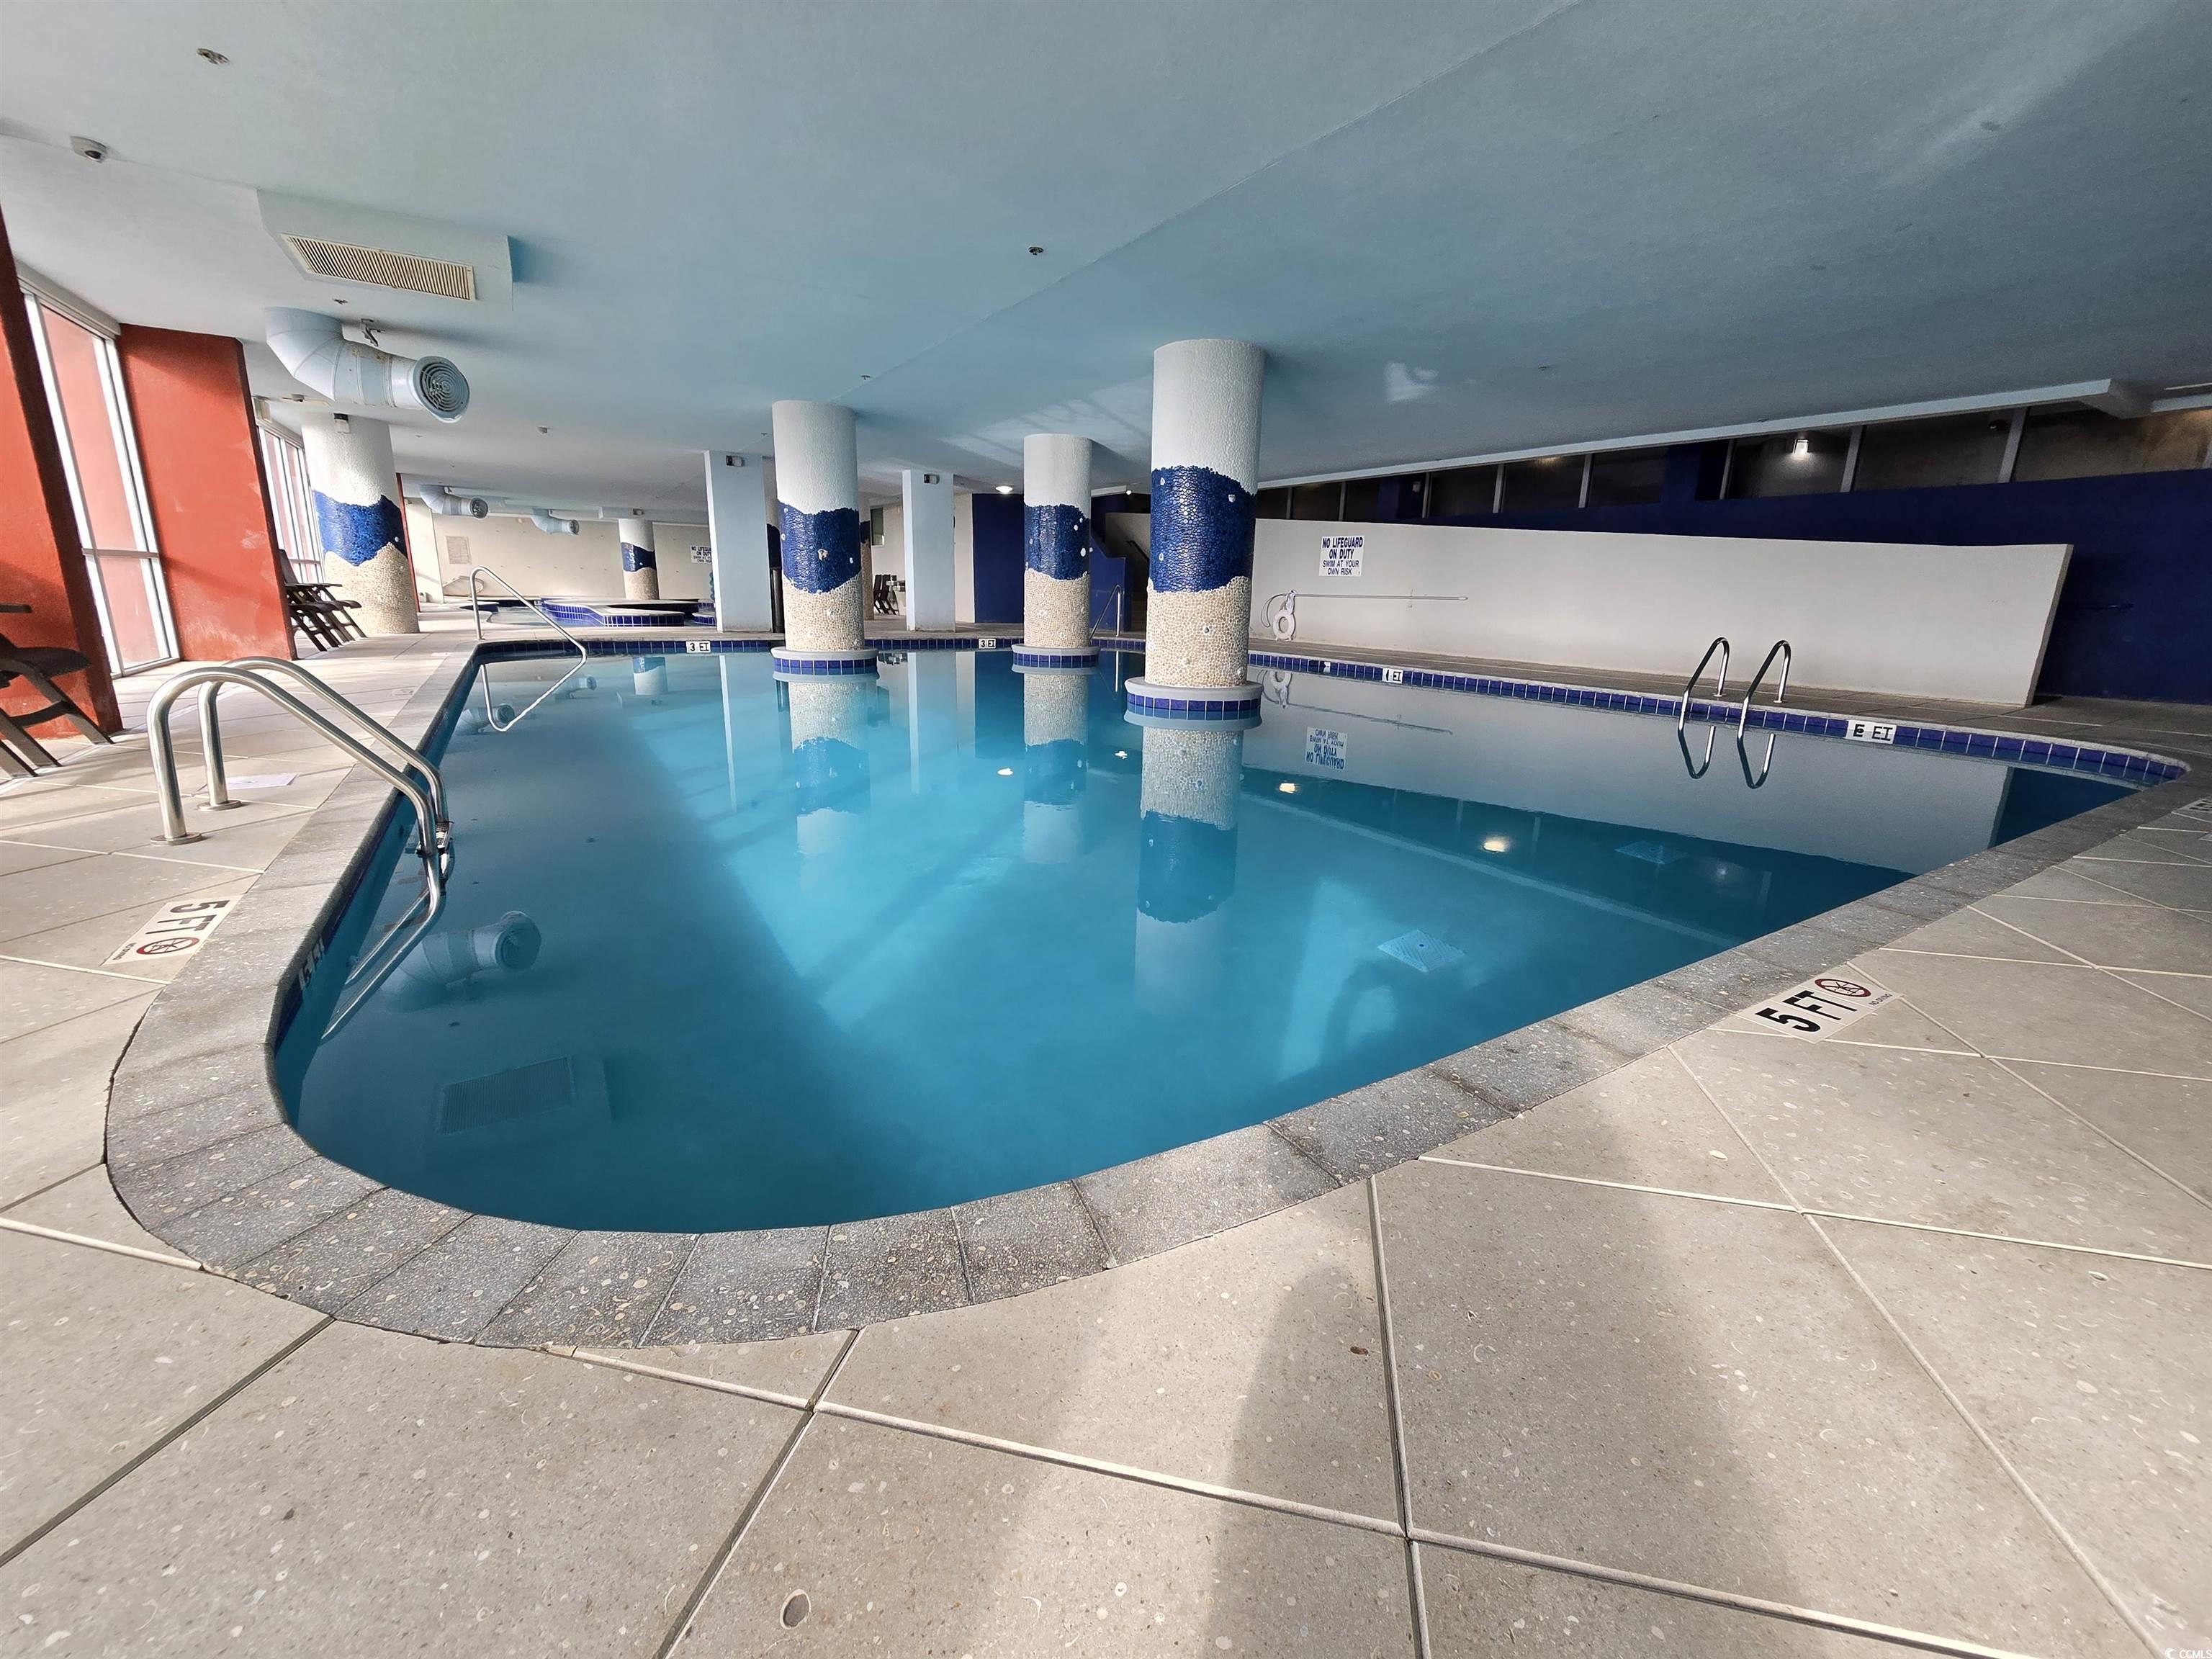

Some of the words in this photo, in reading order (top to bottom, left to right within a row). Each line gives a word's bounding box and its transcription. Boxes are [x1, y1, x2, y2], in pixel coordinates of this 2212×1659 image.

[1322, 537, 1331, 548] NO
[1332, 536, 1363, 548] LIFEGUARD
[1328, 549, 1337, 559] ON
[1339, 549, 1354, 559] DUTY
[170, 900, 230, 913] 5
[145, 914, 217, 935] FT
[1782, 990, 1858, 1020] FT
[1755, 1007, 1821, 1032] 5
